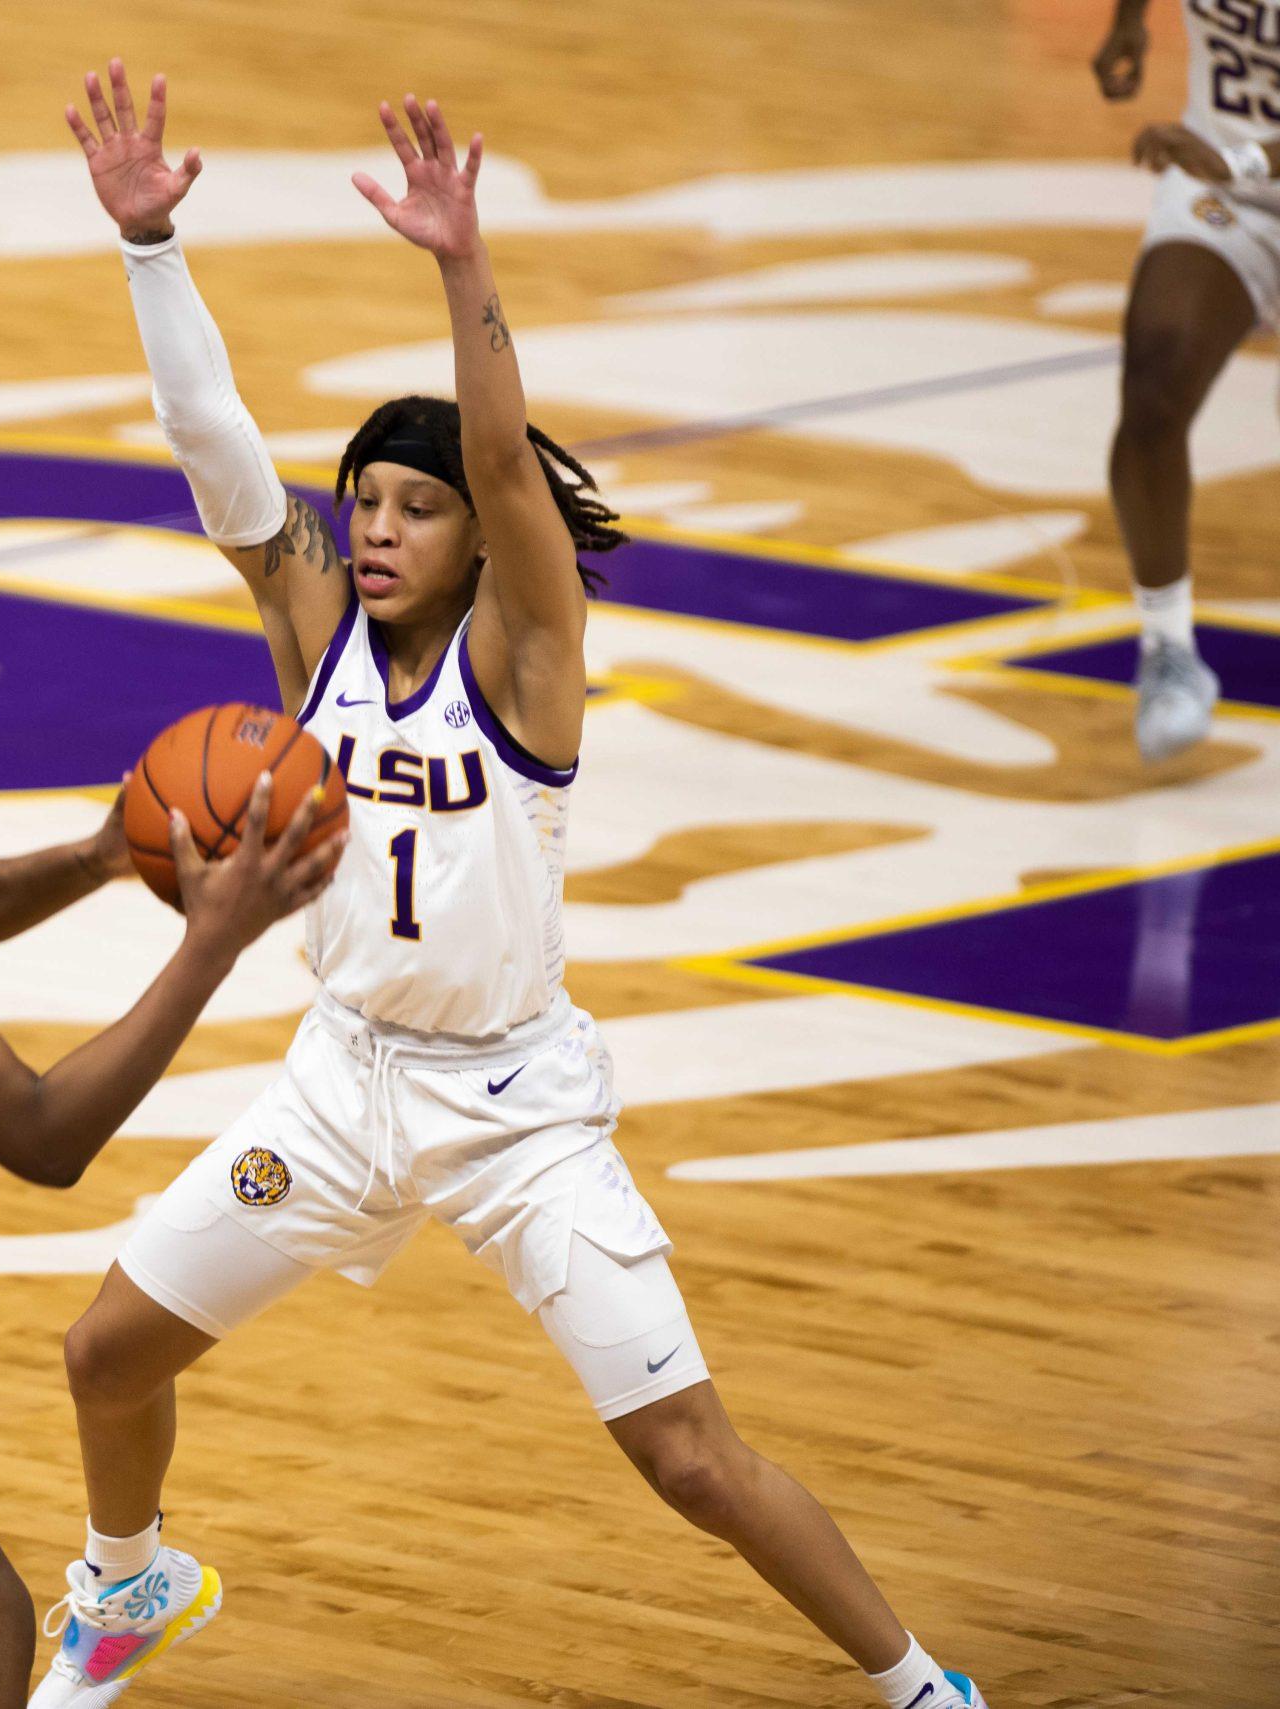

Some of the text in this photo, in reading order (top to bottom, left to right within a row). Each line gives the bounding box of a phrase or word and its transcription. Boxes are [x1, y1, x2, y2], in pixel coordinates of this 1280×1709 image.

[444, 700, 470, 728] SEC
[336, 734, 489, 813] LSU
[389, 824, 423, 942] 1
